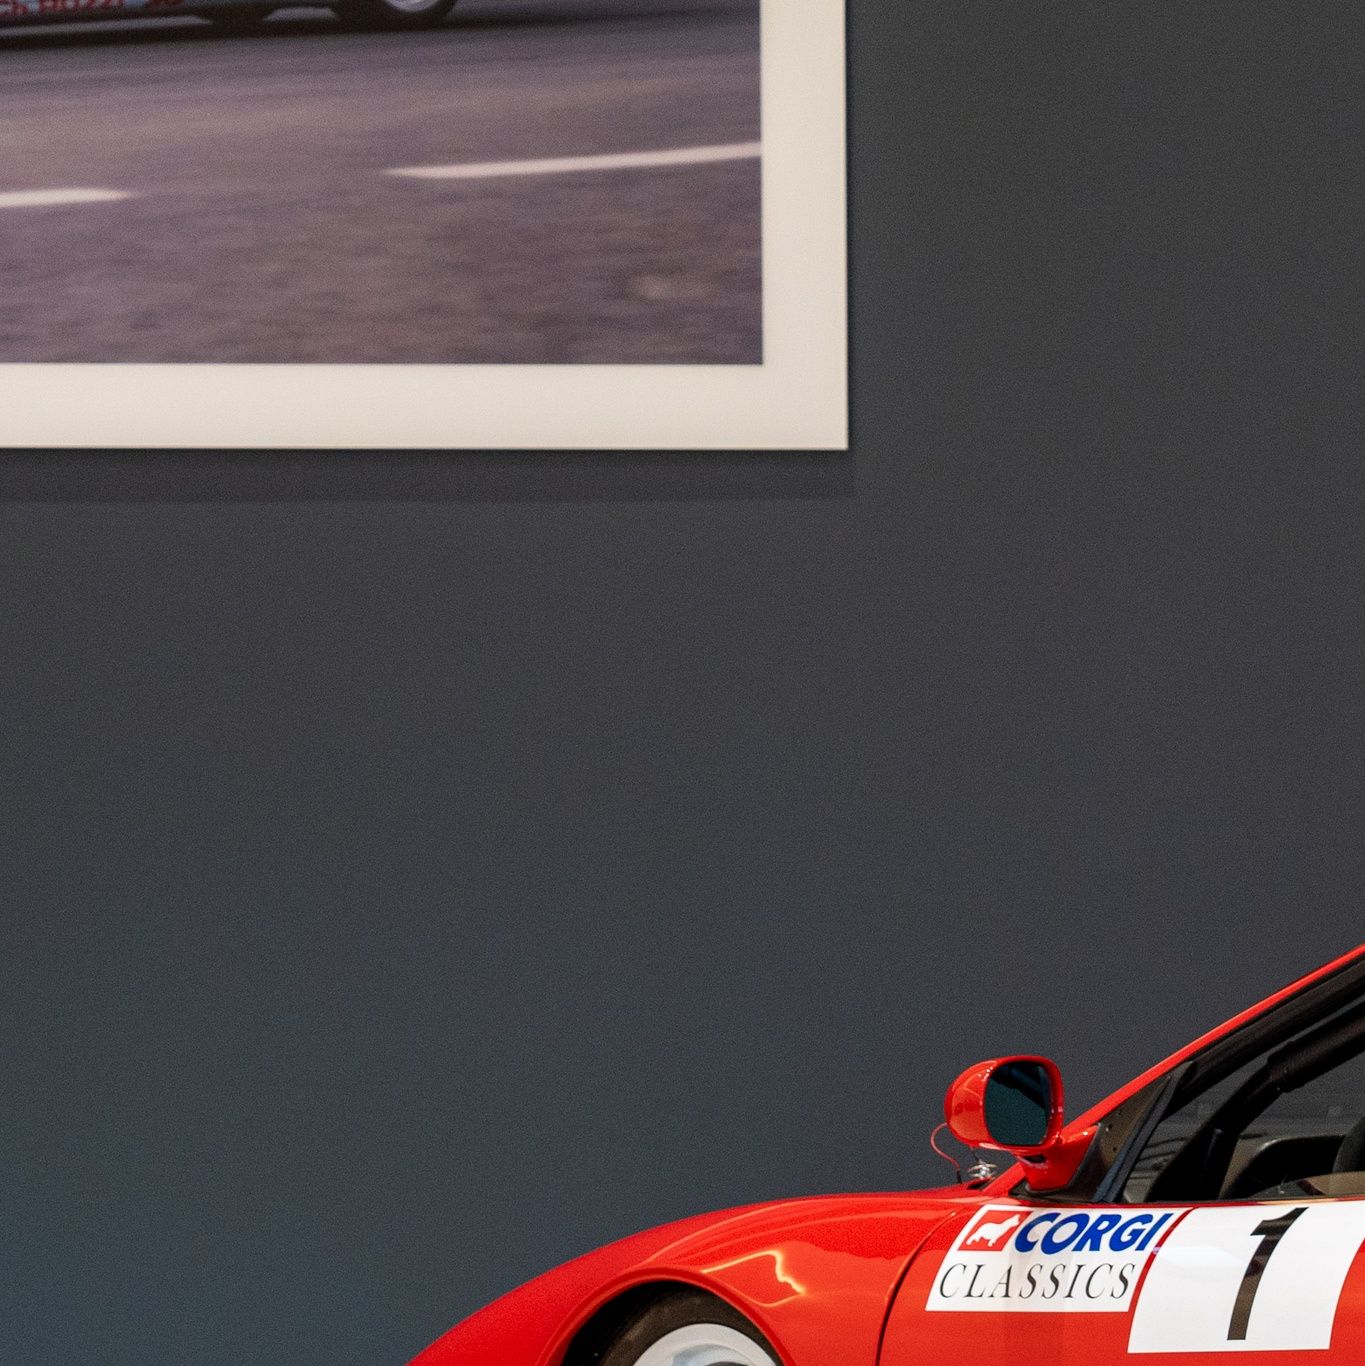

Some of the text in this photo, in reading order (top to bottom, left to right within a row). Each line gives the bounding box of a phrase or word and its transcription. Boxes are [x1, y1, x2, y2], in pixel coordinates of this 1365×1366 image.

[1014, 1211, 1174, 1255] CORGI
[938, 1262, 1136, 1299] CLASSICS
[1226, 1206, 1309, 1341] 1
